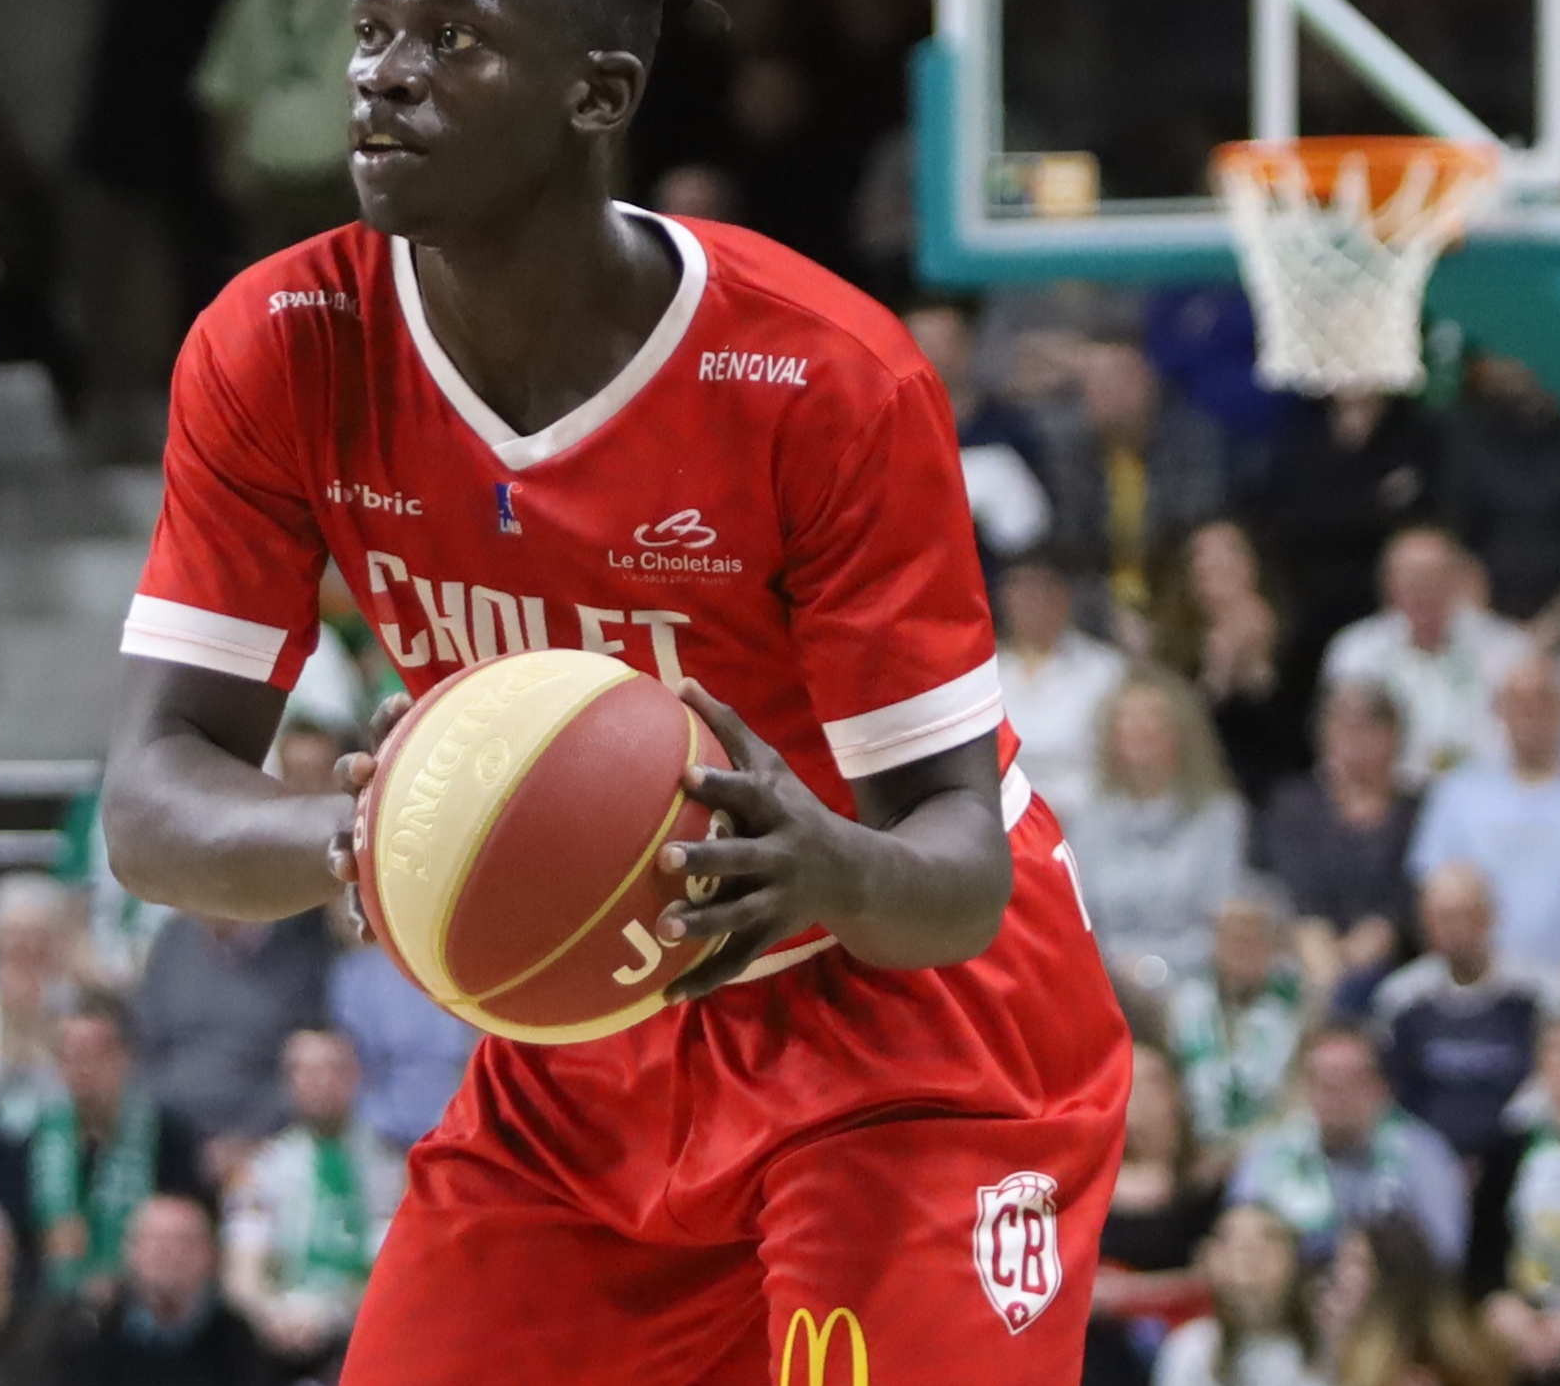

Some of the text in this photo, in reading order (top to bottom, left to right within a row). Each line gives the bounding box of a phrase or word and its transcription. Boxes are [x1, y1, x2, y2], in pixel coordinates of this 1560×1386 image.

[698, 344, 808, 386] RÉNOVAL
[608, 549, 743, 574] Le Choletais
